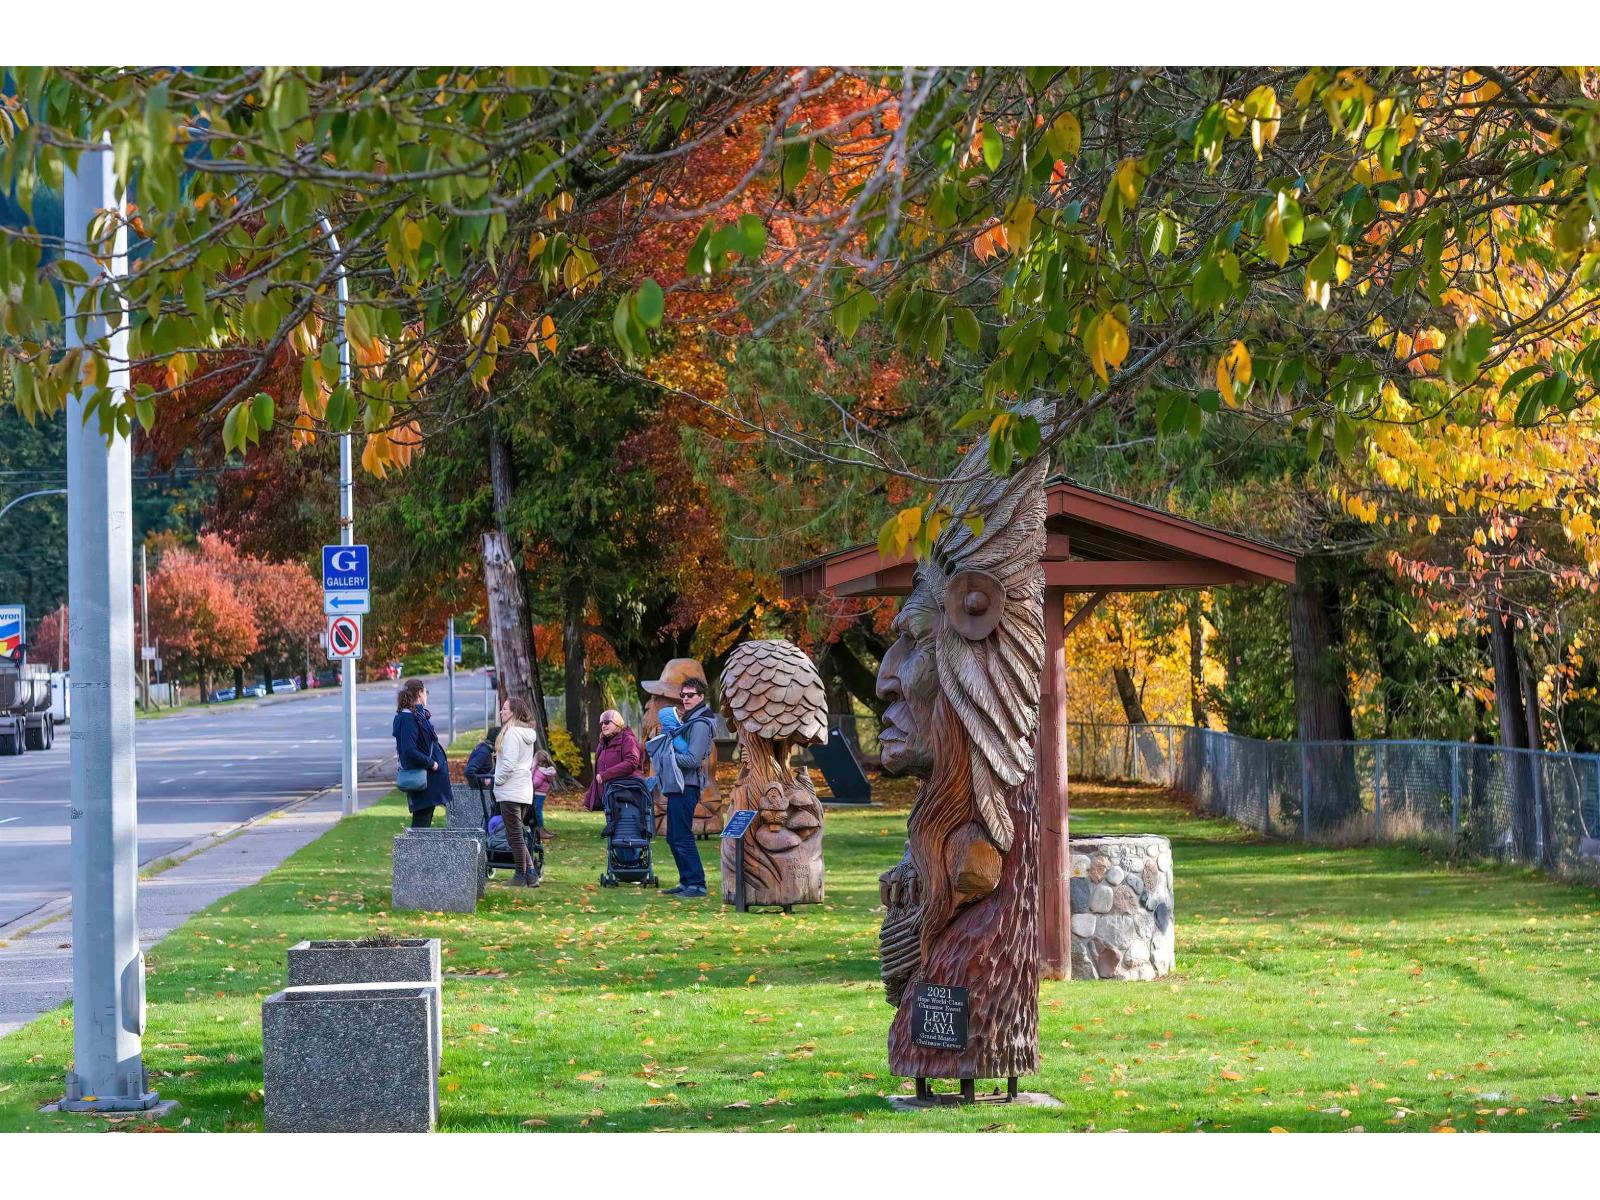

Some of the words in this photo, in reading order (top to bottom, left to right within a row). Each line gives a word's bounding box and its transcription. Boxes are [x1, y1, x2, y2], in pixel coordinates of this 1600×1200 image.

[331, 550, 359, 572] G
[327, 577, 365, 586] GALLERY
[927, 987, 952, 998] 2021
[924, 1010, 954, 1024] LEVI
[924, 1021, 954, 1034] CAYA
